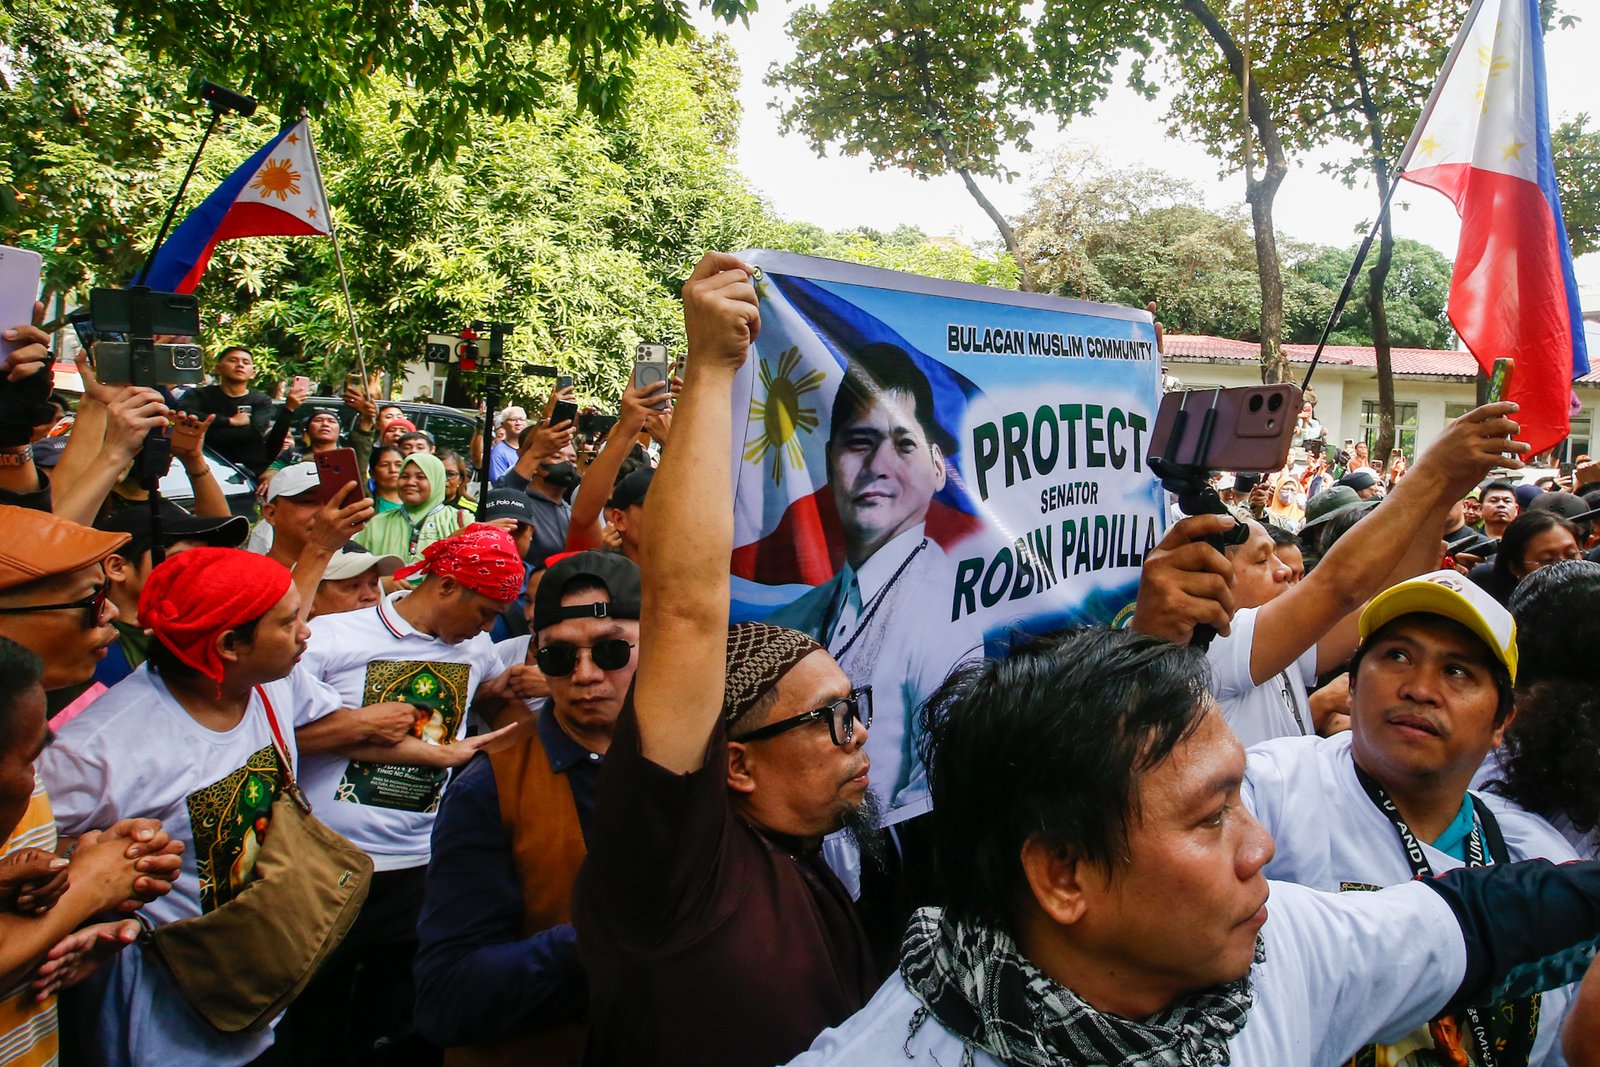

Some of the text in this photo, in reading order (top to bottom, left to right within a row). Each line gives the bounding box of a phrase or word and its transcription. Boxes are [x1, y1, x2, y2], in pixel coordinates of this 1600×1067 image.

[947, 324, 1152, 361] BULACAN MUSLIM COMMUNITY
[973, 403, 1147, 502] PROTECT
[1040, 481, 1098, 514] SENATOR
[951, 514, 1156, 623] ROBIN PADILLA
[1397, 821, 1423, 863] AND
